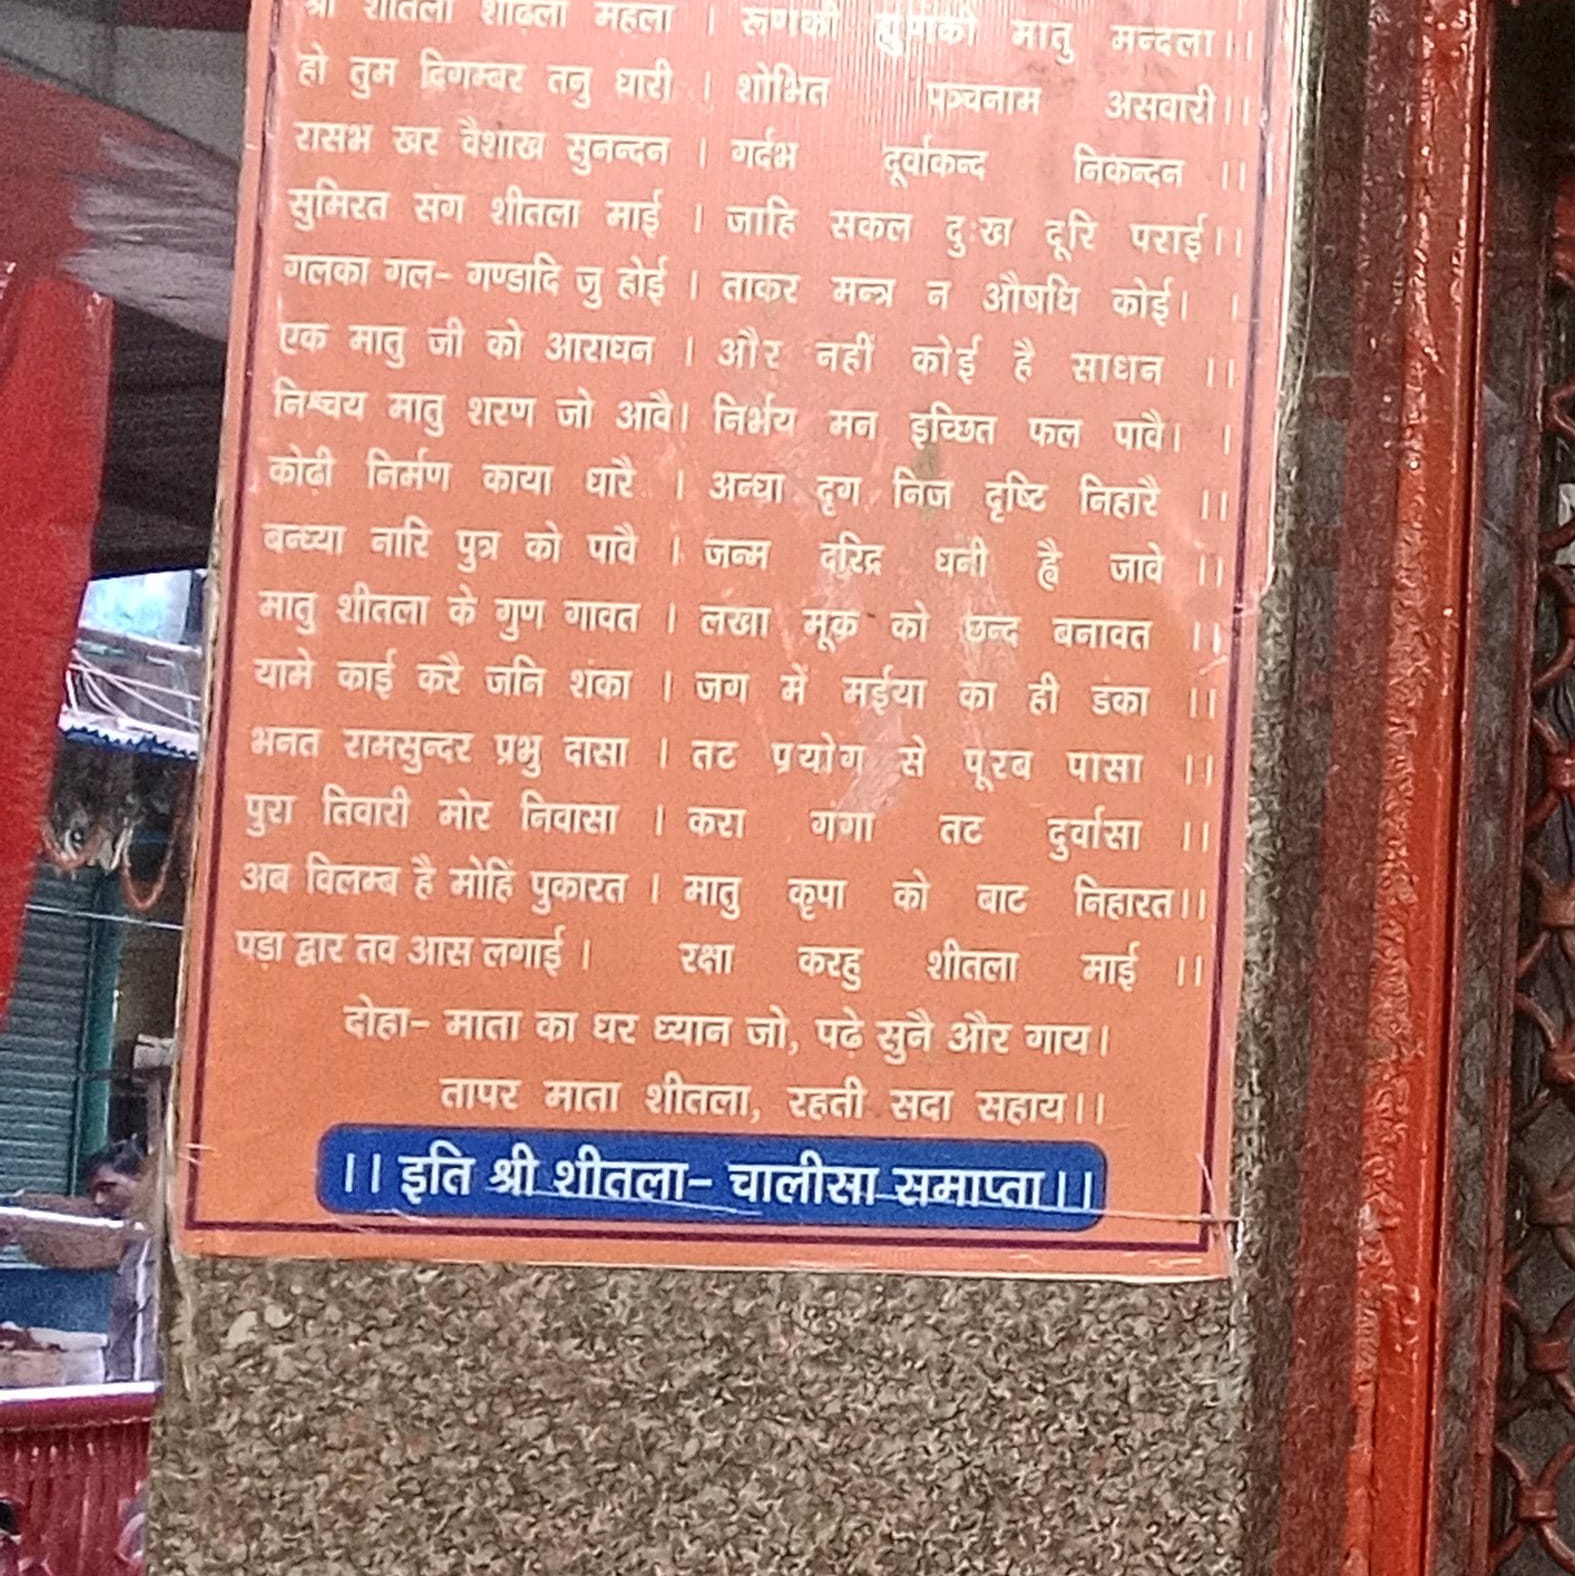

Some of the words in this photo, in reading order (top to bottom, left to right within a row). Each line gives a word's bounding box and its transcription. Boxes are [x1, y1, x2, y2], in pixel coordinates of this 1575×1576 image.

[291, 120, 375, 154] रासभ
[390, 124, 443, 157] खर
[563, 132, 672, 177] सुनन्दन
[729, 124, 799, 171] गर्दभ
[286, 175, 391, 232] सुमिरत
[411, 191, 467, 225] संग
[488, 183, 583, 229] शीतला
[603, 187, 664, 239] माई
[346, 323, 409, 370] मातु
[425, 314, 466, 358] जी
[484, 316, 525, 361] को
[813, 330, 876, 376] नहीं
[242, 792, 298, 838] पुरा
[320, 781, 412, 829] तिवारी
[435, 785, 495, 832] मोर
[518, 787, 621, 836] निवासा
[238, 860, 293, 894] अब
[305, 849, 403, 897] विलम्ब
[409, 852, 438, 901] है
[446, 852, 517, 904] मोहिं
[527, 869, 630, 916] पुकारत
[682, 874, 744, 921] मातु
[785, 877, 849, 921] कृपा
[890, 866, 932, 912] को
[975, 882, 1030, 914] बाट
[441, 1008, 524, 1041] माता
[652, 1013, 734, 1047] ध्यान
[743, 1003, 799, 1056] जो,
[812, 1004, 865, 1059] पढ़े
[873, 1006, 935, 1065] सुनै
[946, 1009, 1015, 1054] और
[438, 1076, 522, 1115] तापर
[542, 1077, 623, 1114] माता
[643, 1070, 764, 1123] शीतला,
[785, 1075, 868, 1121] रहती
[889, 1087, 955, 1124] सदा
[397, 1139, 478, 1207] इति
[488, 1140, 540, 1199] श्री
[728, 1150, 880, 1210] चालीसा
